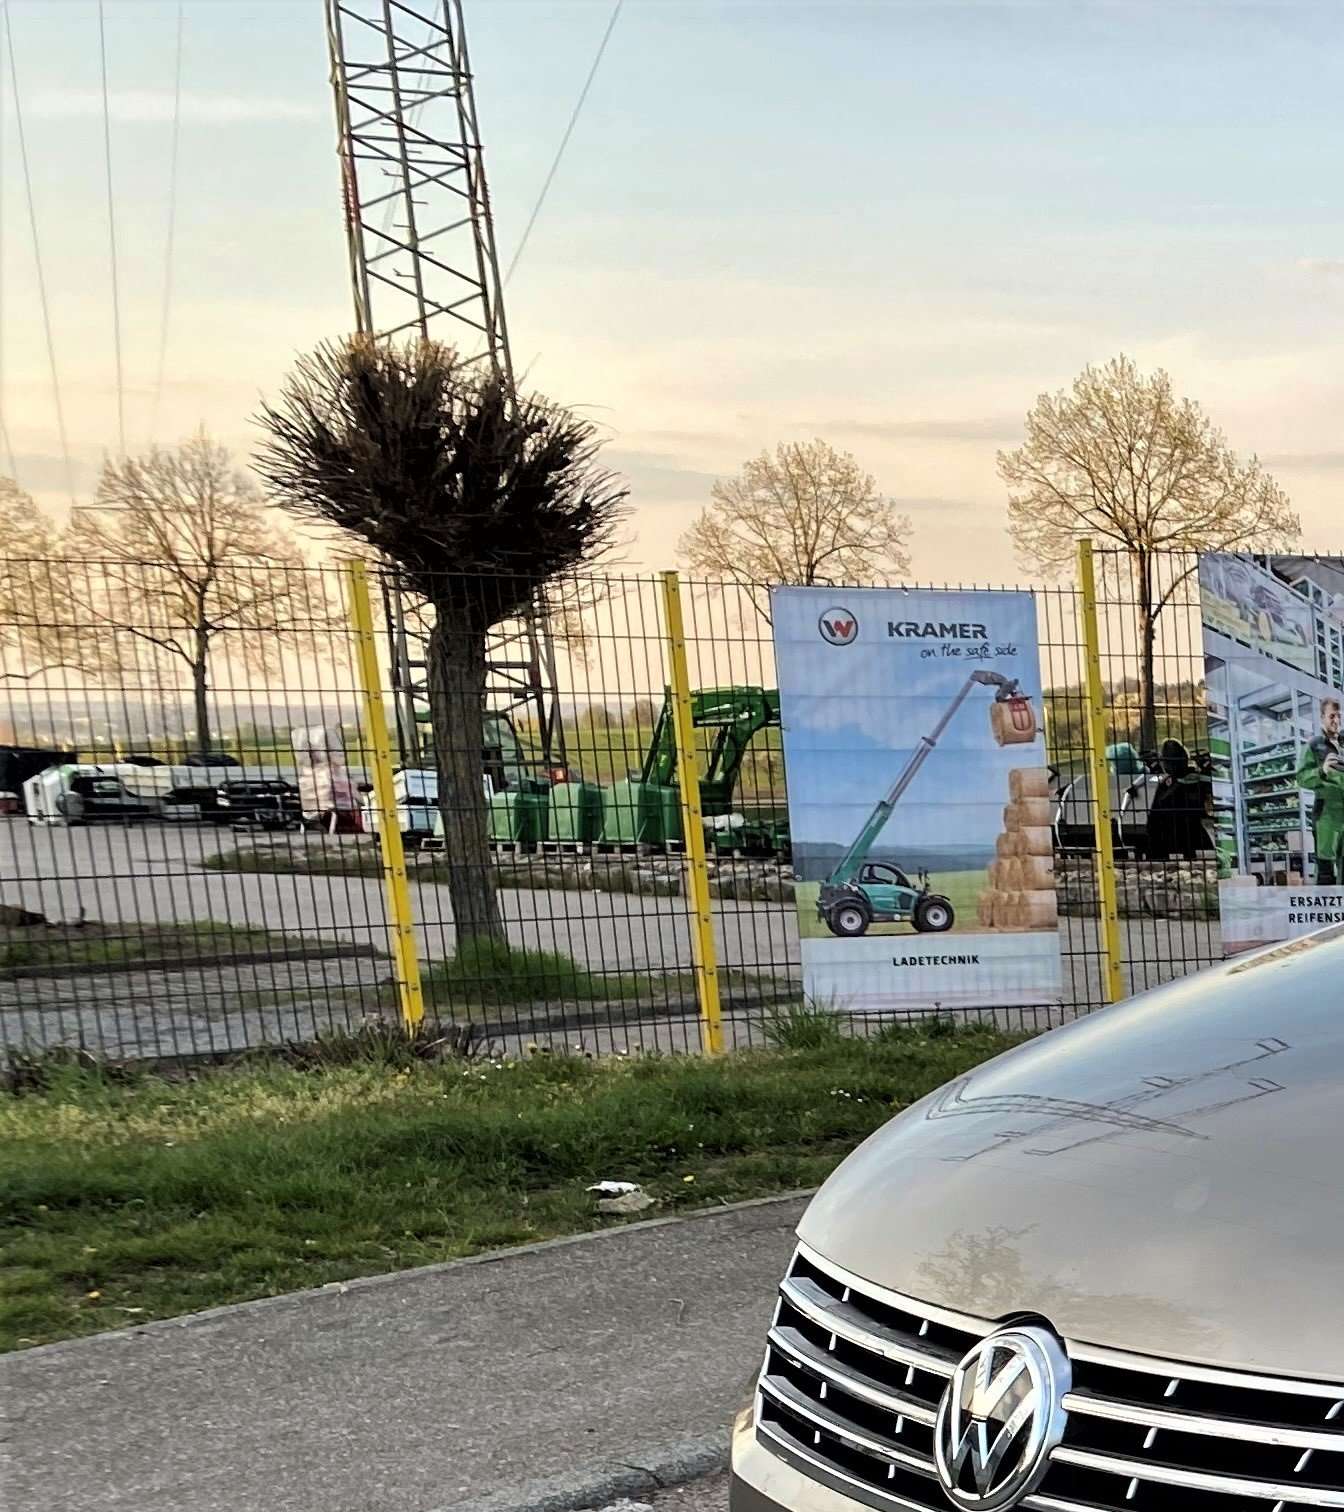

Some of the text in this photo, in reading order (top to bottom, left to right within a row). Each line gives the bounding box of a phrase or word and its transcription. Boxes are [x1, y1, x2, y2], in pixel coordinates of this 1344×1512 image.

[887, 621, 988, 640] KRAMER
[920, 642, 1018, 661] on the safe side
[892, 954, 980, 967] LADETECHNIK
